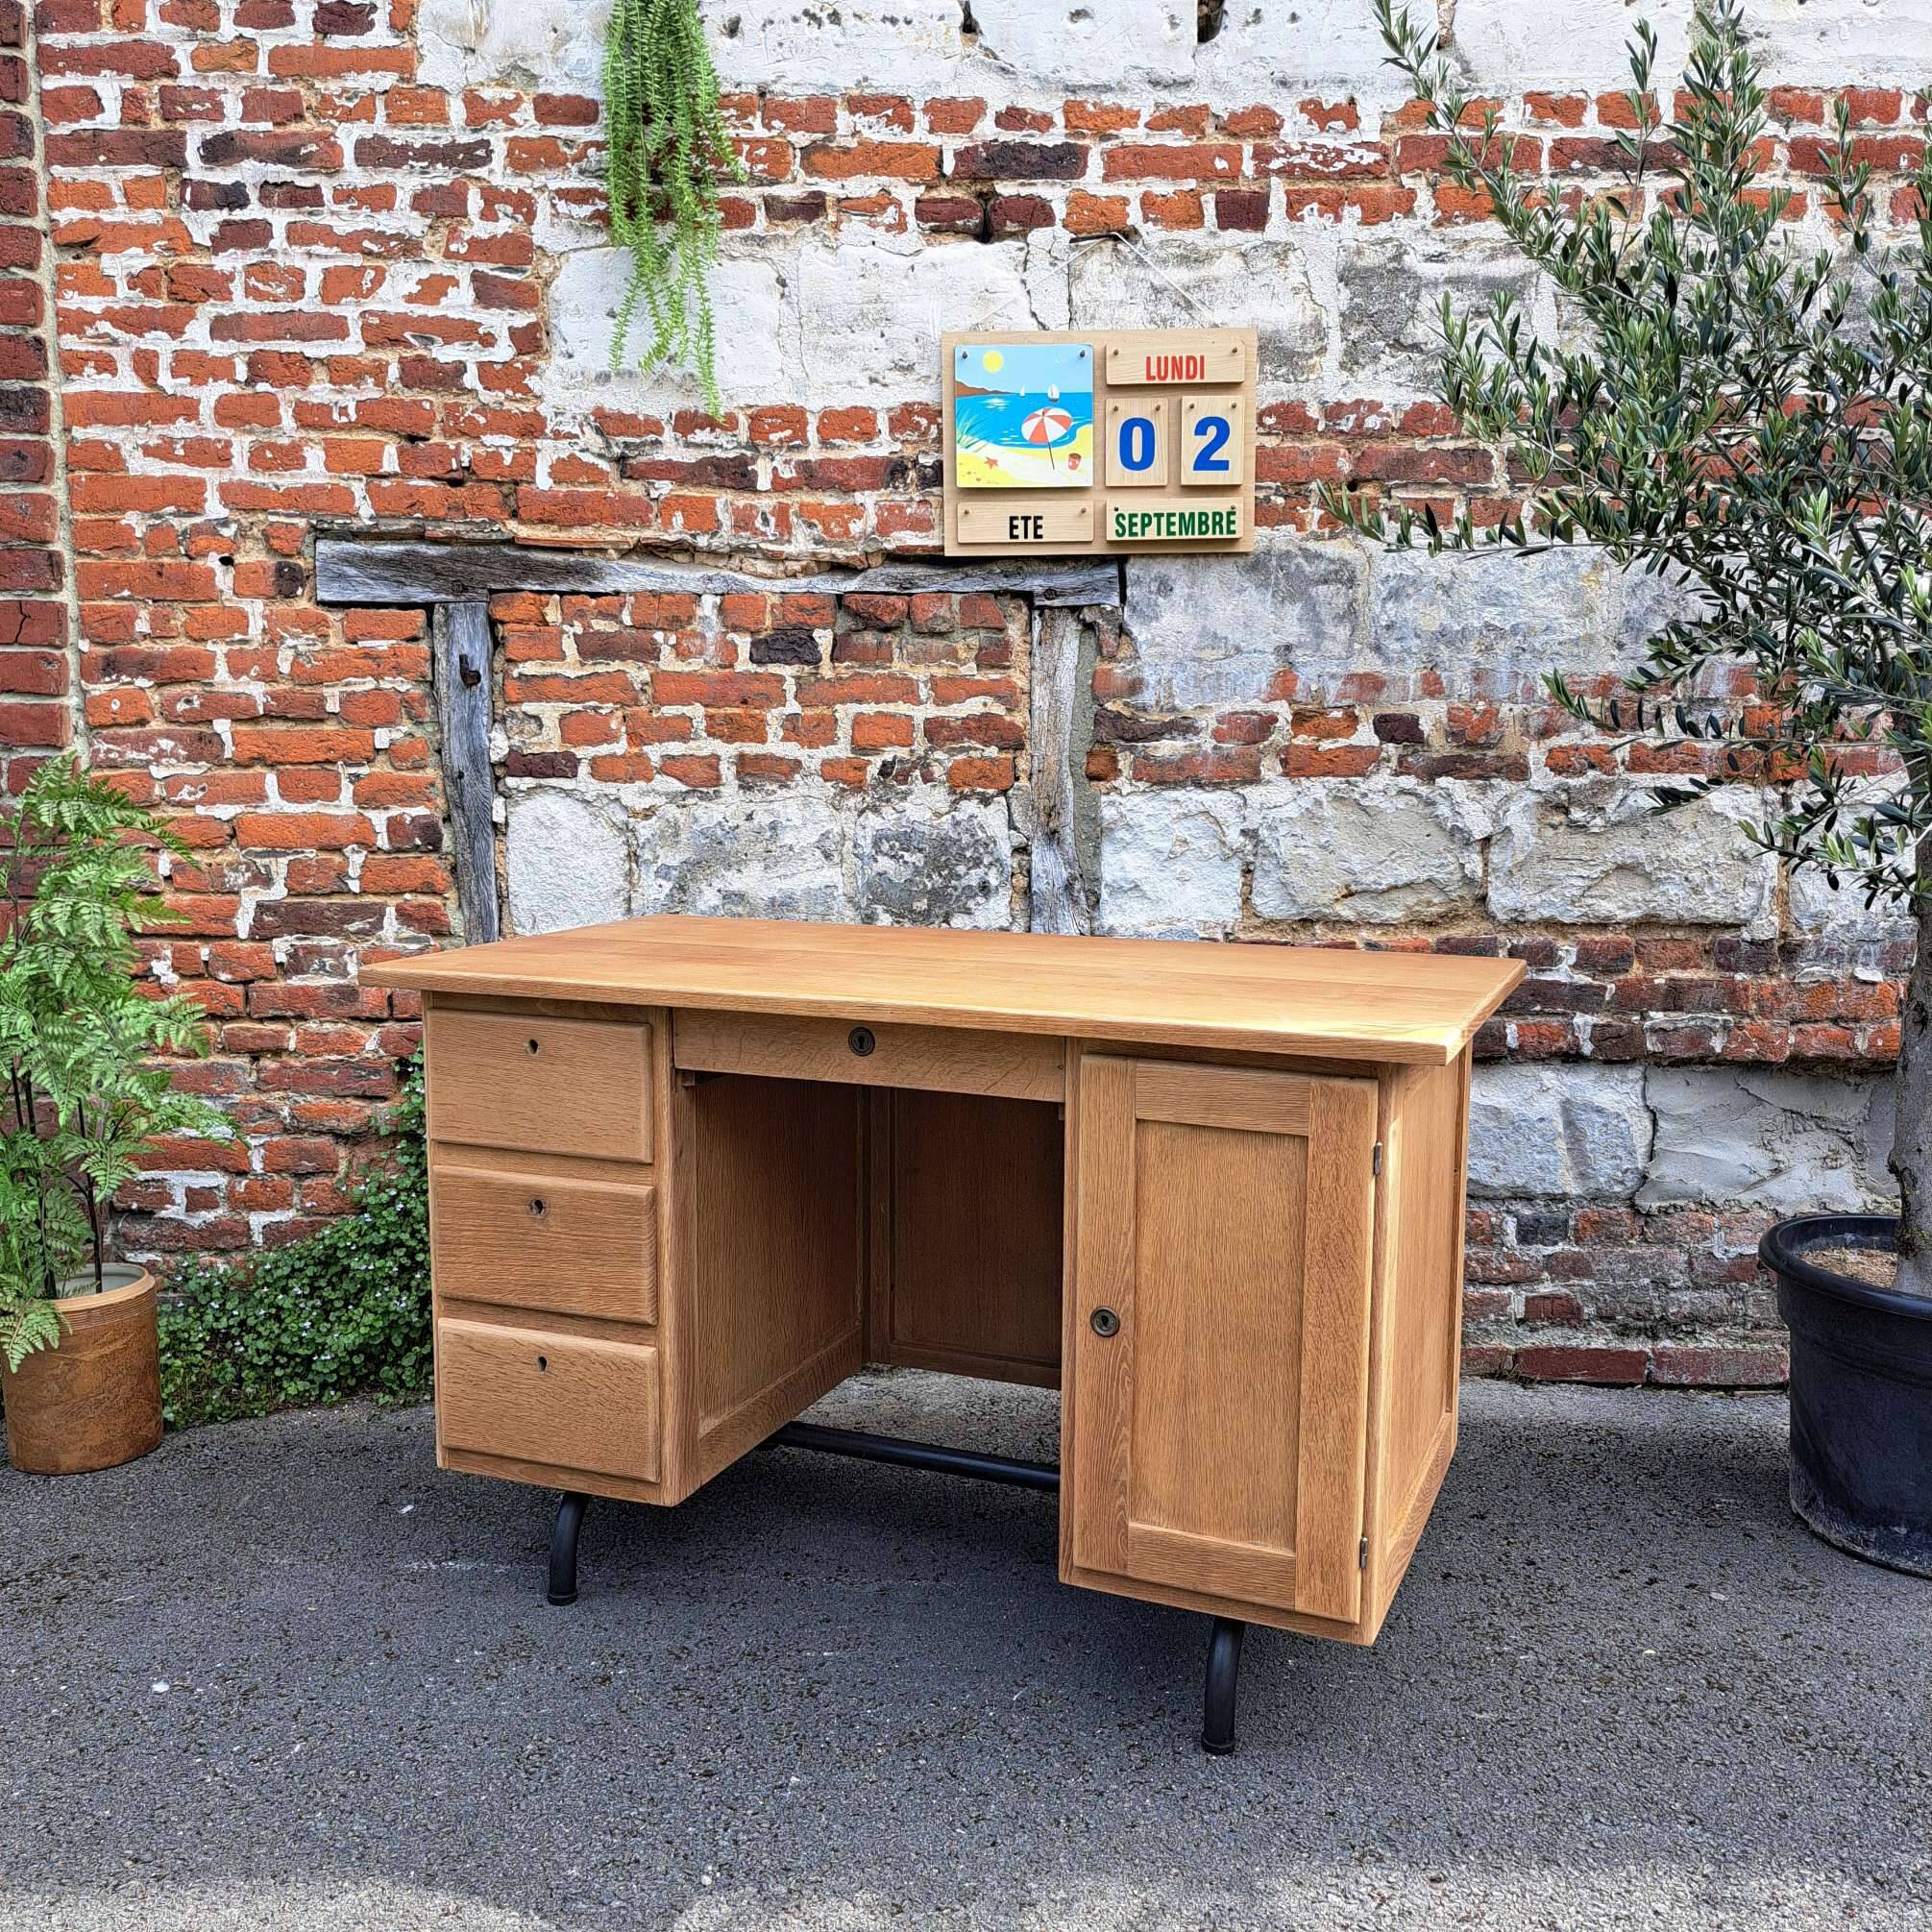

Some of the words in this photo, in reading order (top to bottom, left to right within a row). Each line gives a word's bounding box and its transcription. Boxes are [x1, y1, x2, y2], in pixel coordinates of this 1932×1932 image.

[1145, 355, 1205, 381] LUNDI
[1119, 417, 1156, 472] 0
[1192, 416, 1231, 472] 2
[1009, 515, 1043, 540] ETE
[1114, 510, 1236, 538] SEPTEMBRE
